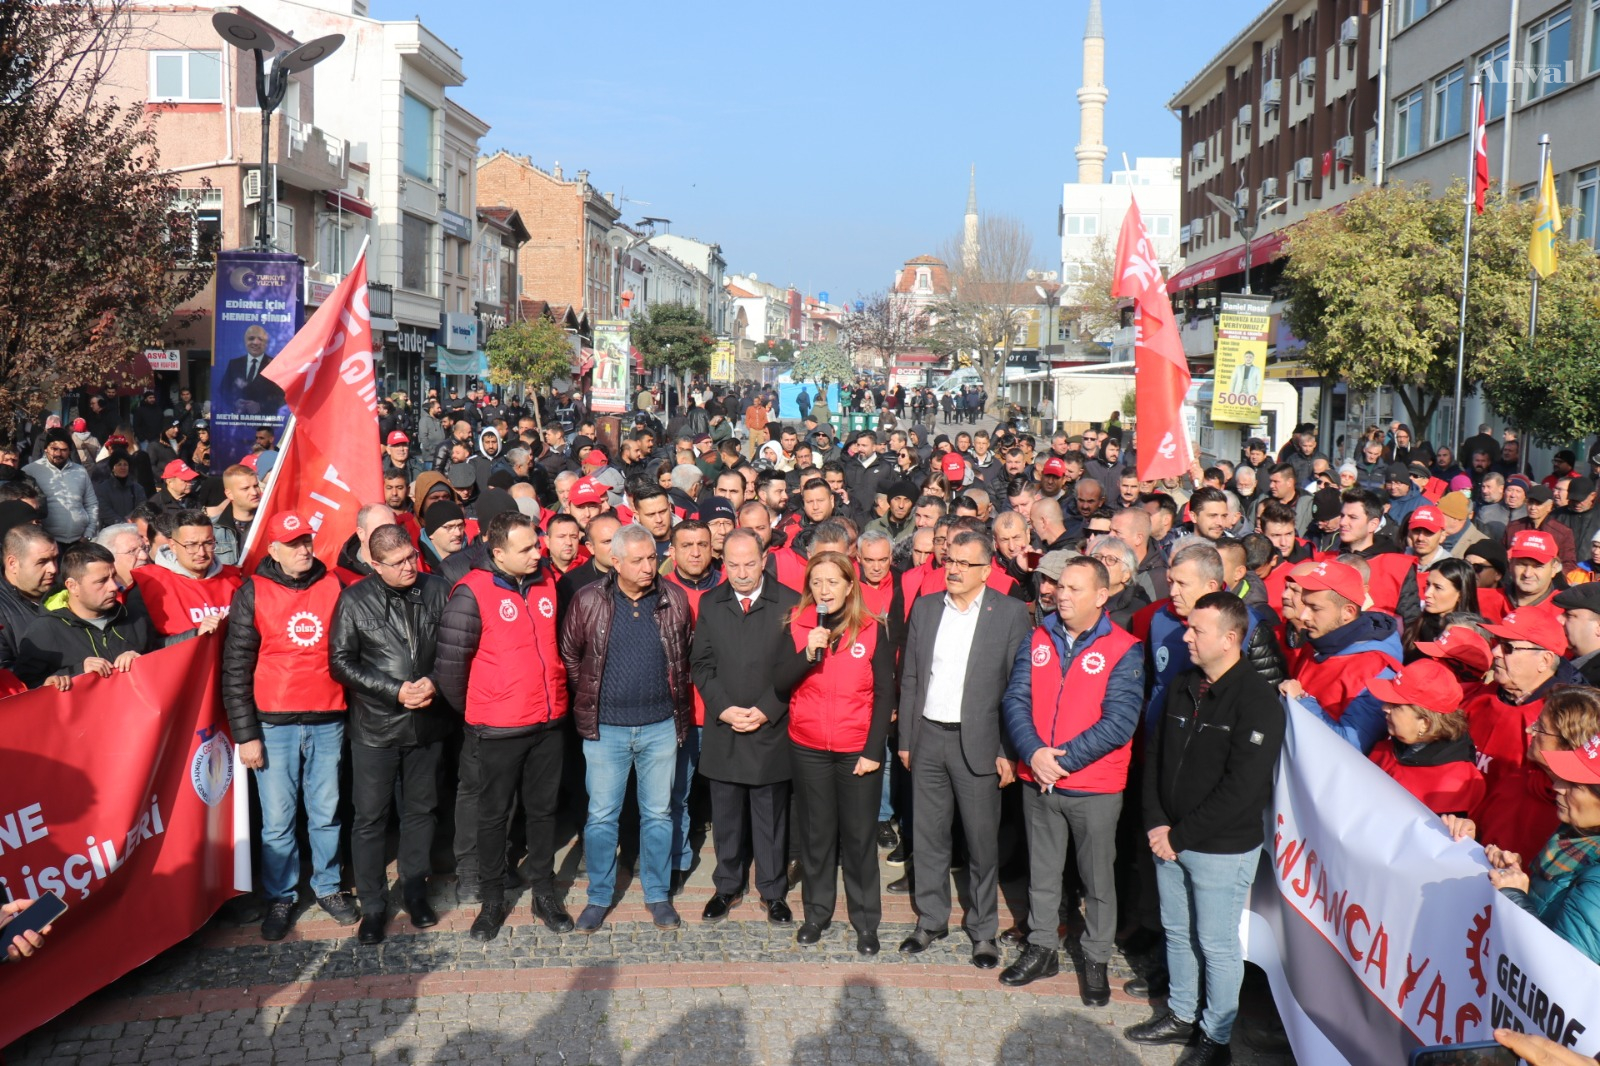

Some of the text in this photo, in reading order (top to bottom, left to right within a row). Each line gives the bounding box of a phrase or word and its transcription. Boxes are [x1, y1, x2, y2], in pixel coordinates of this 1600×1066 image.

[225, 299, 286, 312] EDİRNE İÇİN
[1223, 302, 1269, 312] Daniel Rossi
[222, 312, 292, 325] HEMEN ŞİMDİ
[398, 327, 427, 353] ender
[148, 352, 167, 360] ASYA
[216, 413, 239, 421] METİN
[295, 623, 316, 633] DİSK
[1274, 813, 1389, 989] İNSANCA
